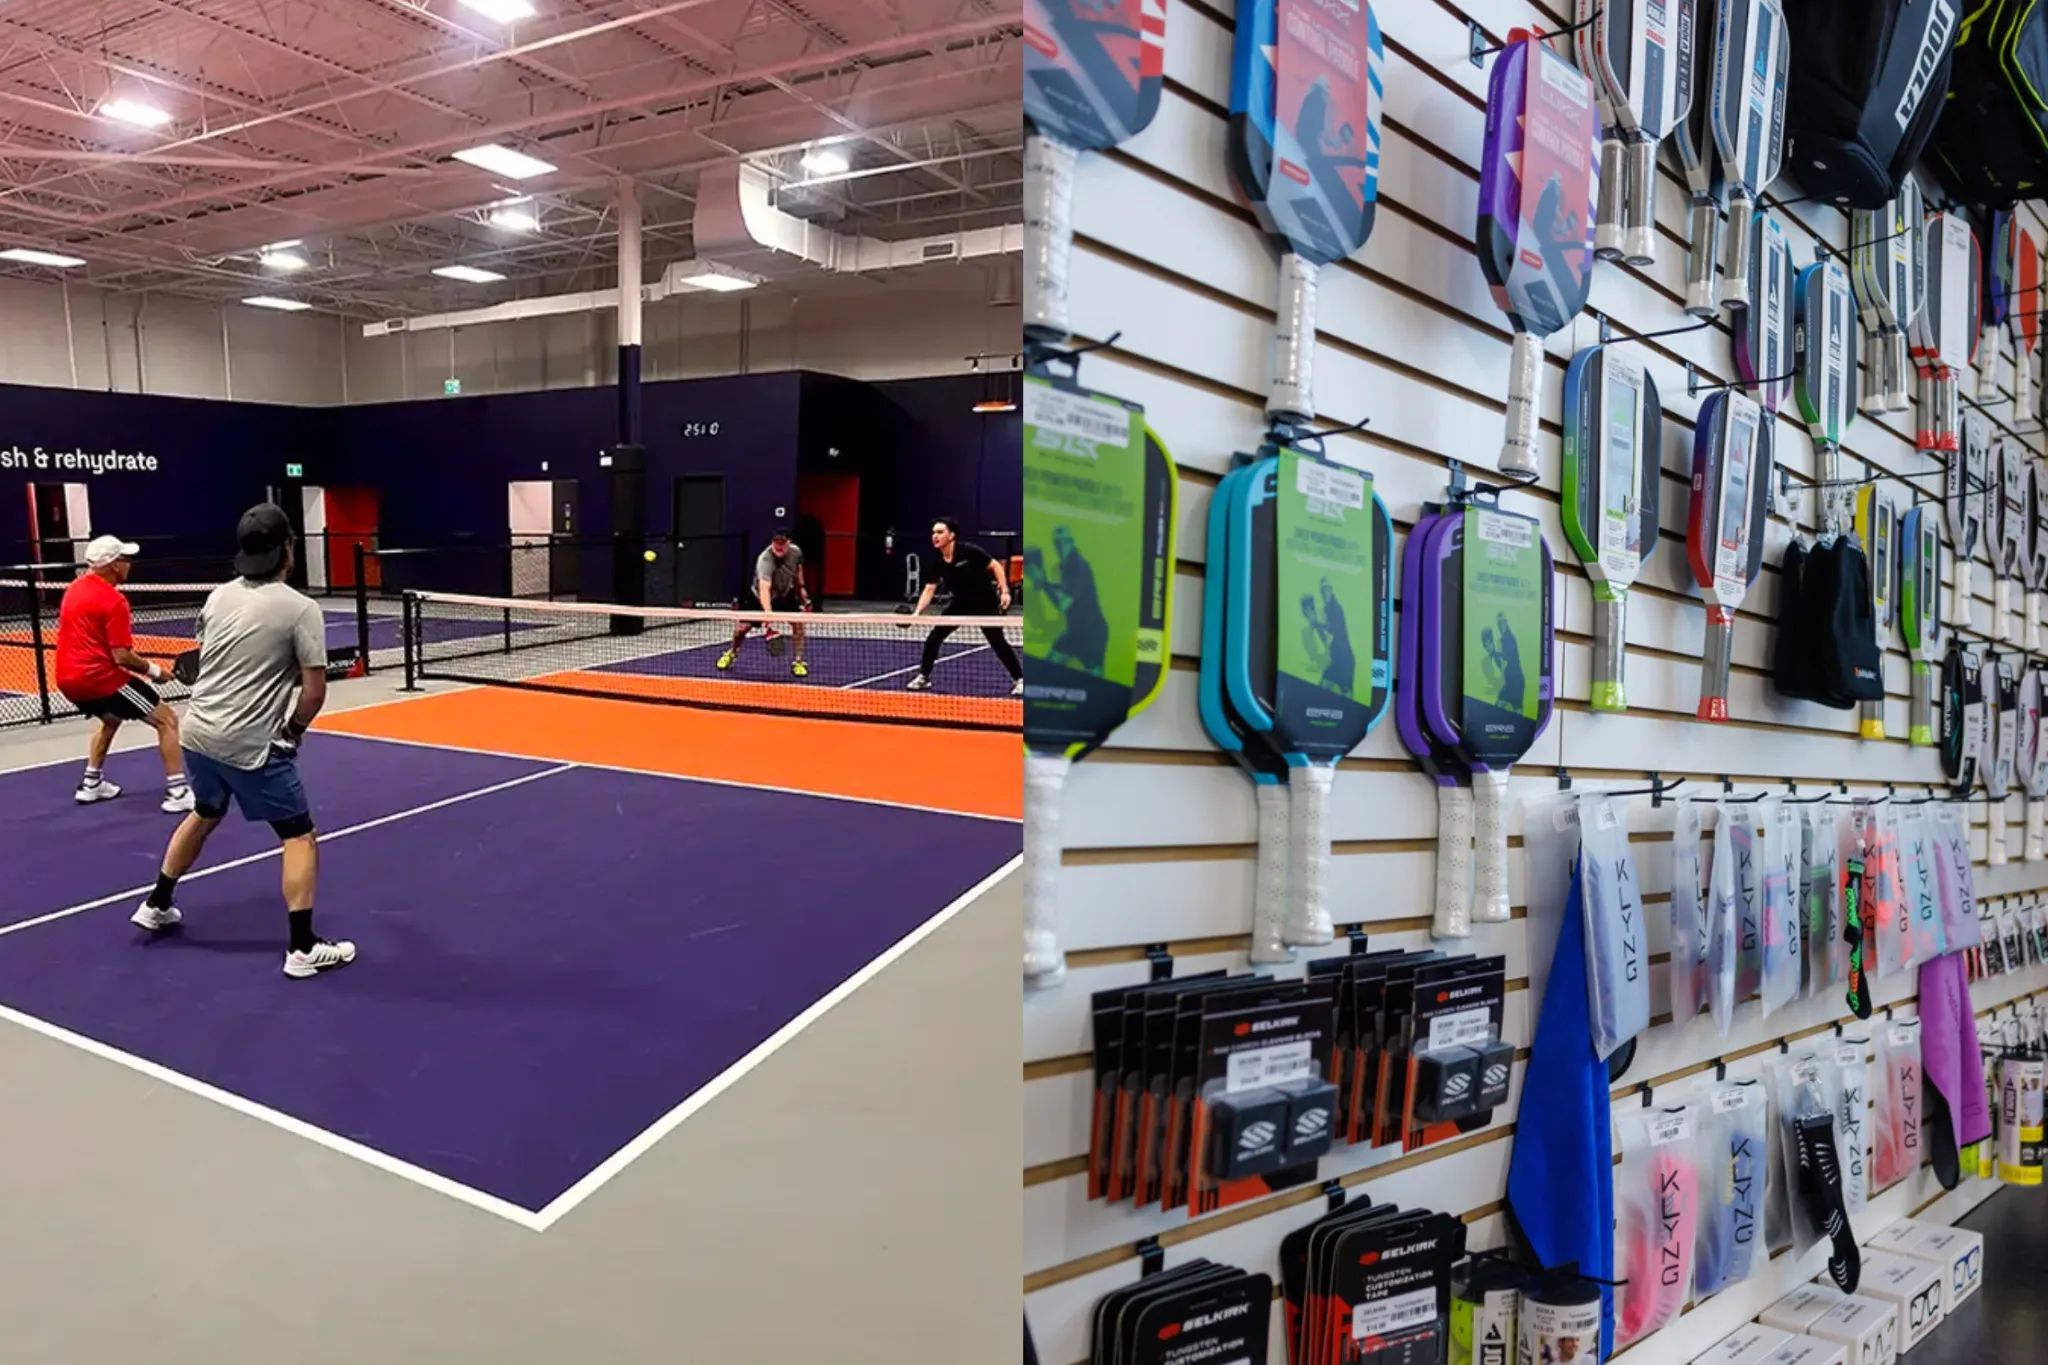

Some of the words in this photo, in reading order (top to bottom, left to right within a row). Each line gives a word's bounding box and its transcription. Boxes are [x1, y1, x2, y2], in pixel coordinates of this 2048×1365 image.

[1900, 0, 1949, 120] JOOLA
[33, 447, 49, 468] &
[55, 448, 158, 474] rehydrate
[1740, 851, 1756, 951] KLYNG
[1784, 852, 1797, 955] KLYNG
[1915, 841, 1932, 921] KLYNG
[1952, 839, 1971, 915] KLYNG
[1615, 858, 1638, 983] KLYNG
[1251, 1016, 1300, 1033] SELKIRK
[1448, 985, 1484, 1000] SELKIRK
[1845, 1087, 1862, 1176] KLYNG
[1901, 1066, 1916, 1148] KLYNG
[1661, 1169, 1680, 1286] KLYNG
[1731, 1138, 1753, 1244] KLYNG
[1366, 1270, 1434, 1292] CUSTOMIZATION
[1367, 1267, 1412, 1283] TUNGSTEN
[1381, 1238, 1439, 1260] SELKIRK
[1182, 1302, 1252, 1333] SELKIRK
[1366, 1289, 1389, 1300] TAPE
